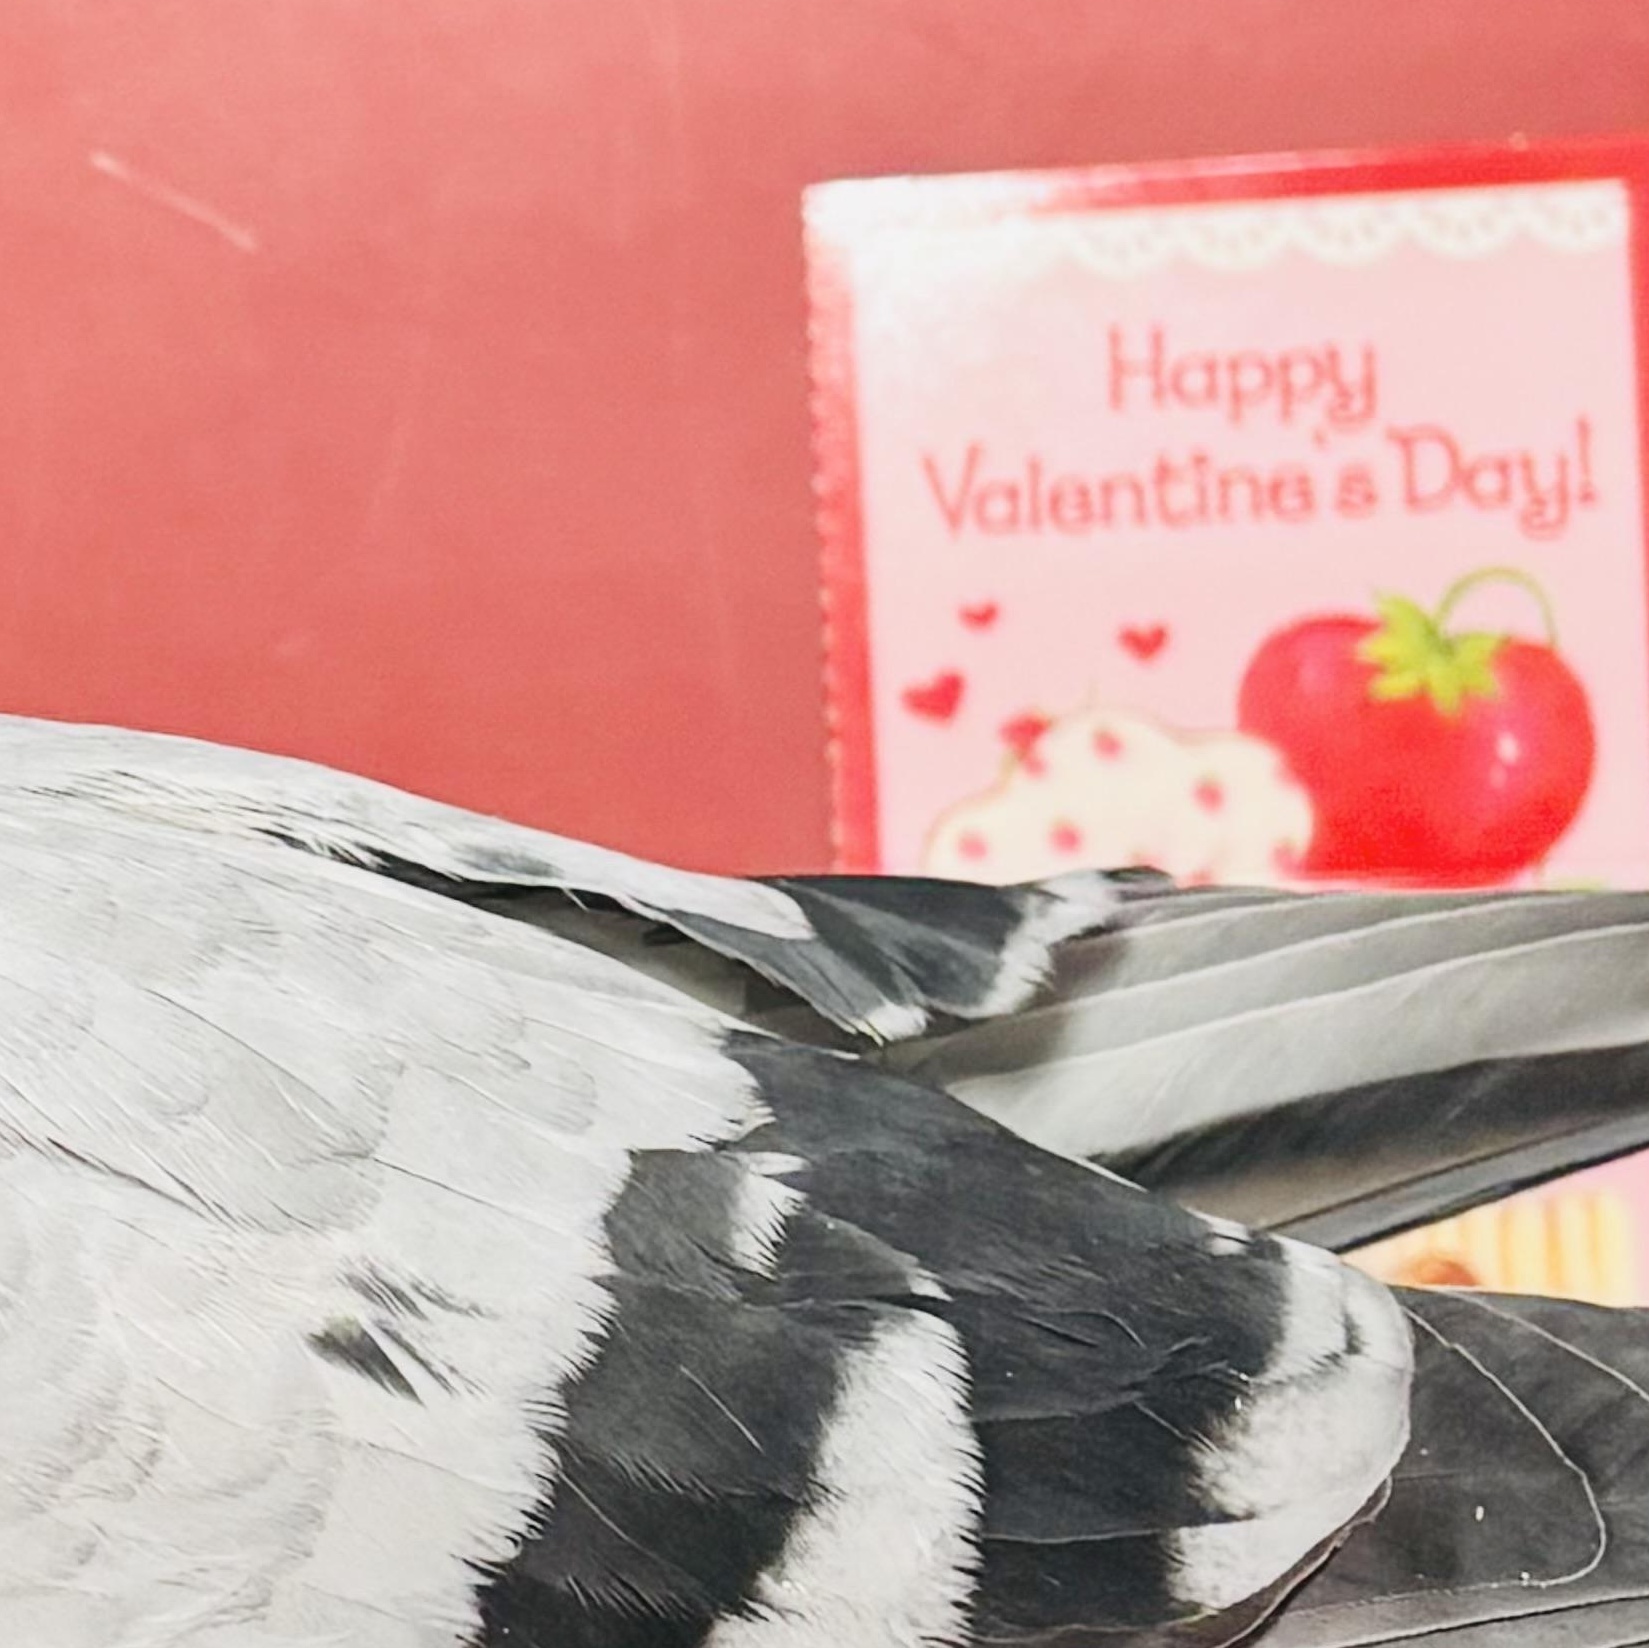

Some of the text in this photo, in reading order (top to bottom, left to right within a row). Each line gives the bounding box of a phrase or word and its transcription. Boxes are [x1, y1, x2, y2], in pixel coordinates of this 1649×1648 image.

[1106, 324, 1378, 424] Happy
[922, 414, 1601, 540] Valentine's Day!
